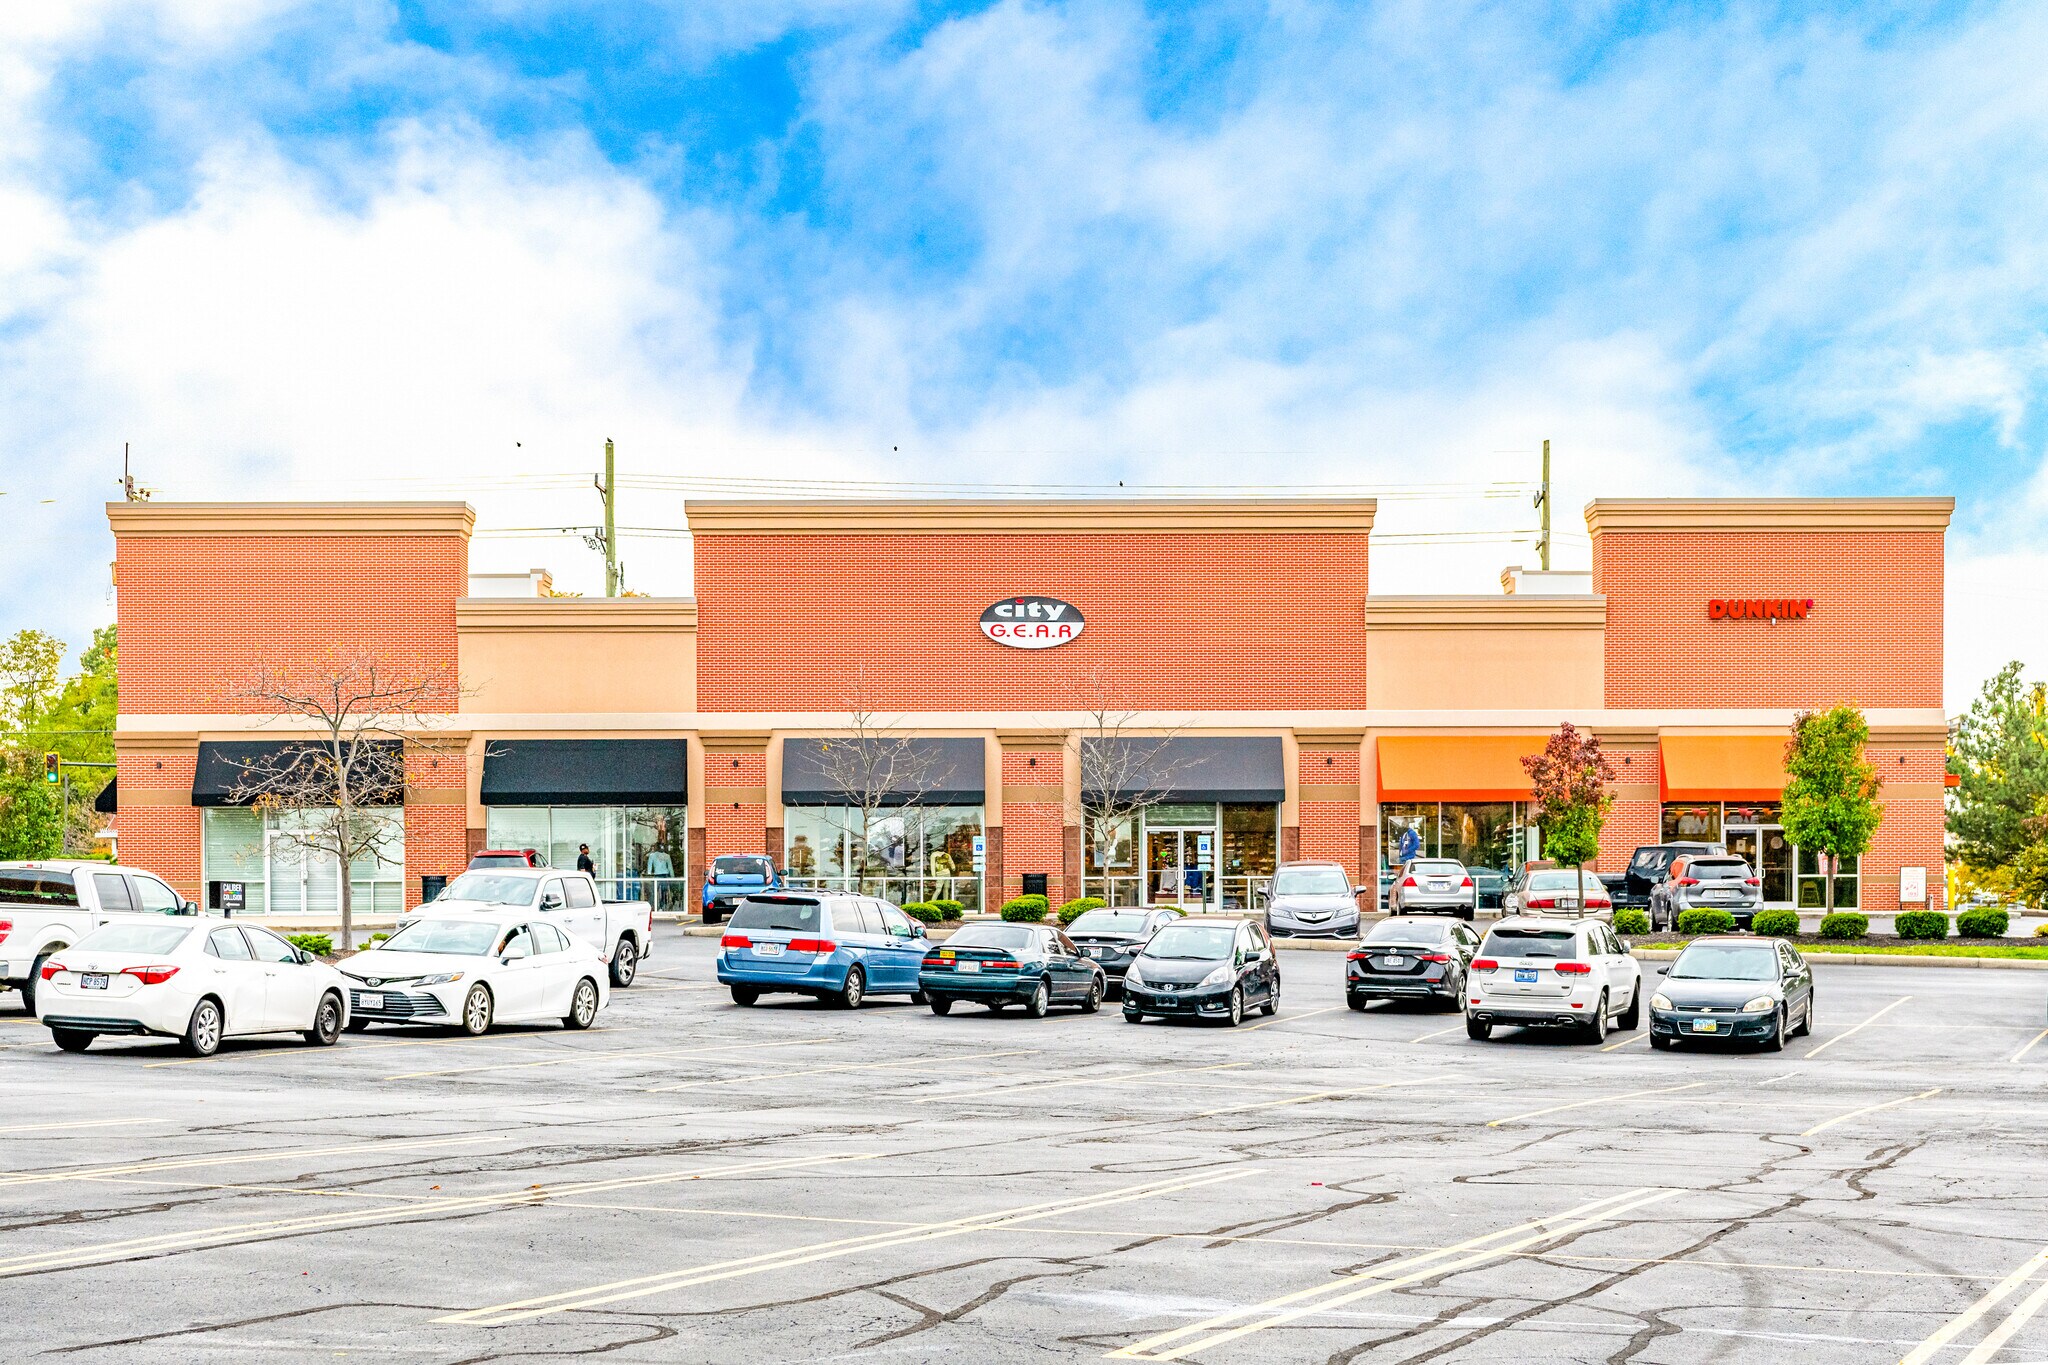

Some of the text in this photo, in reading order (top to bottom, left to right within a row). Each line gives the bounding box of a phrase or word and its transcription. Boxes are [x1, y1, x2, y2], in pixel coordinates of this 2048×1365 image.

[994, 598, 1067, 621] city
[1709, 599, 1814, 620] DUNKIN'
[989, 623, 1072, 638] G.E.A.R
[223, 883, 242, 891] CALIBER
